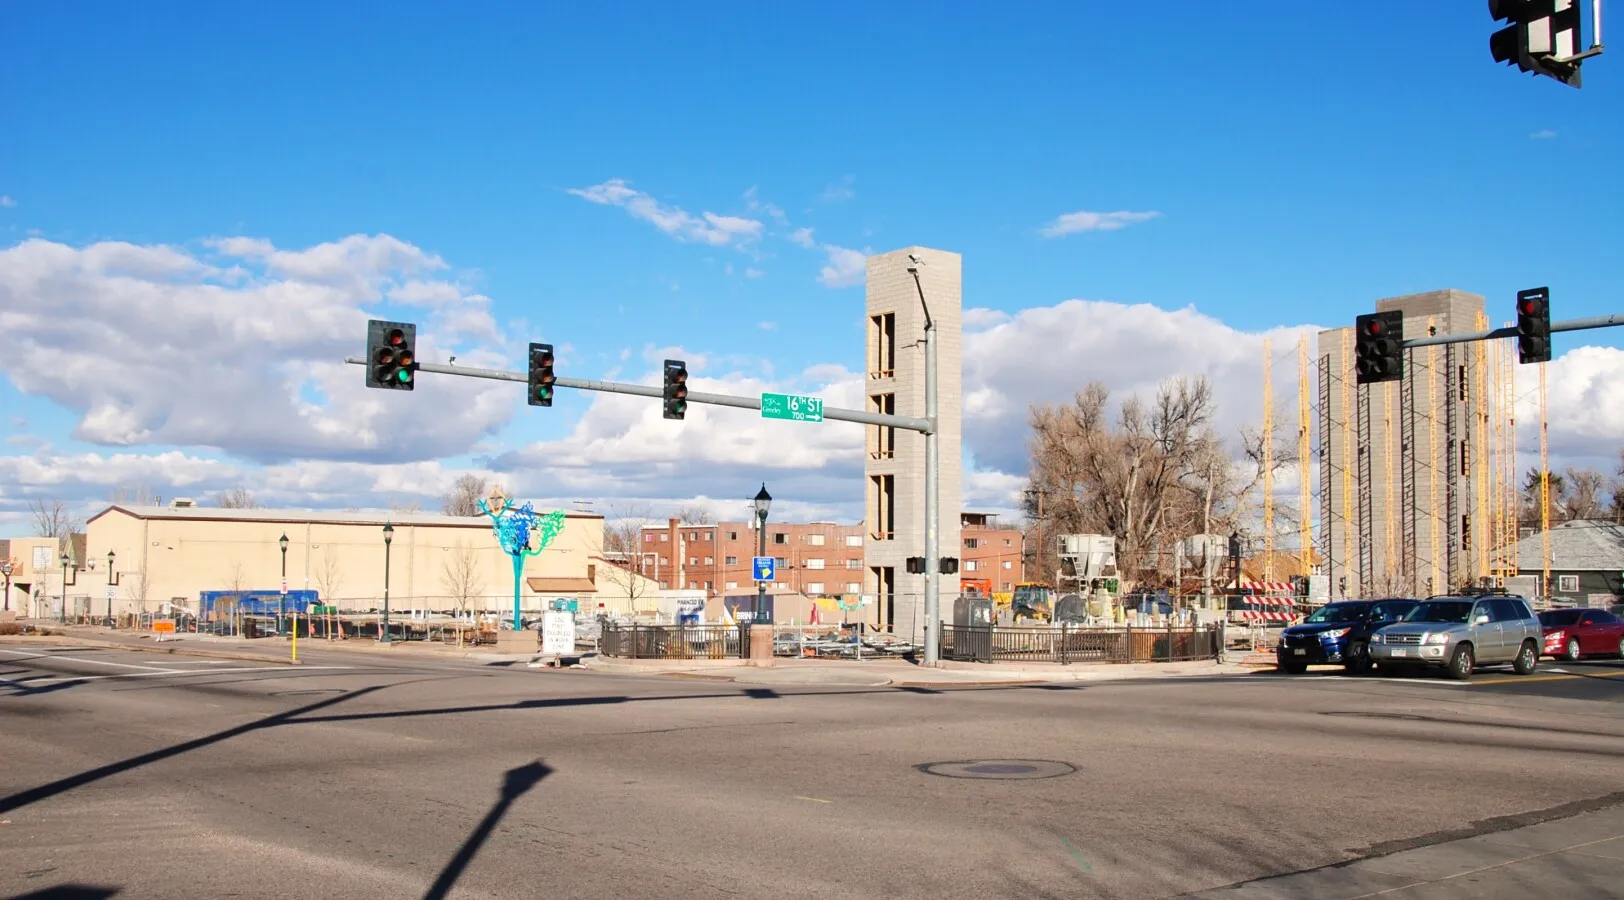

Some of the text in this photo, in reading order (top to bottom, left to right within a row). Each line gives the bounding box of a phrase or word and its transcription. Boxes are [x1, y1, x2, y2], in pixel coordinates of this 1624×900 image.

[787, 396, 822, 413] 16TH ST
[792, 411, 805, 420] 700
